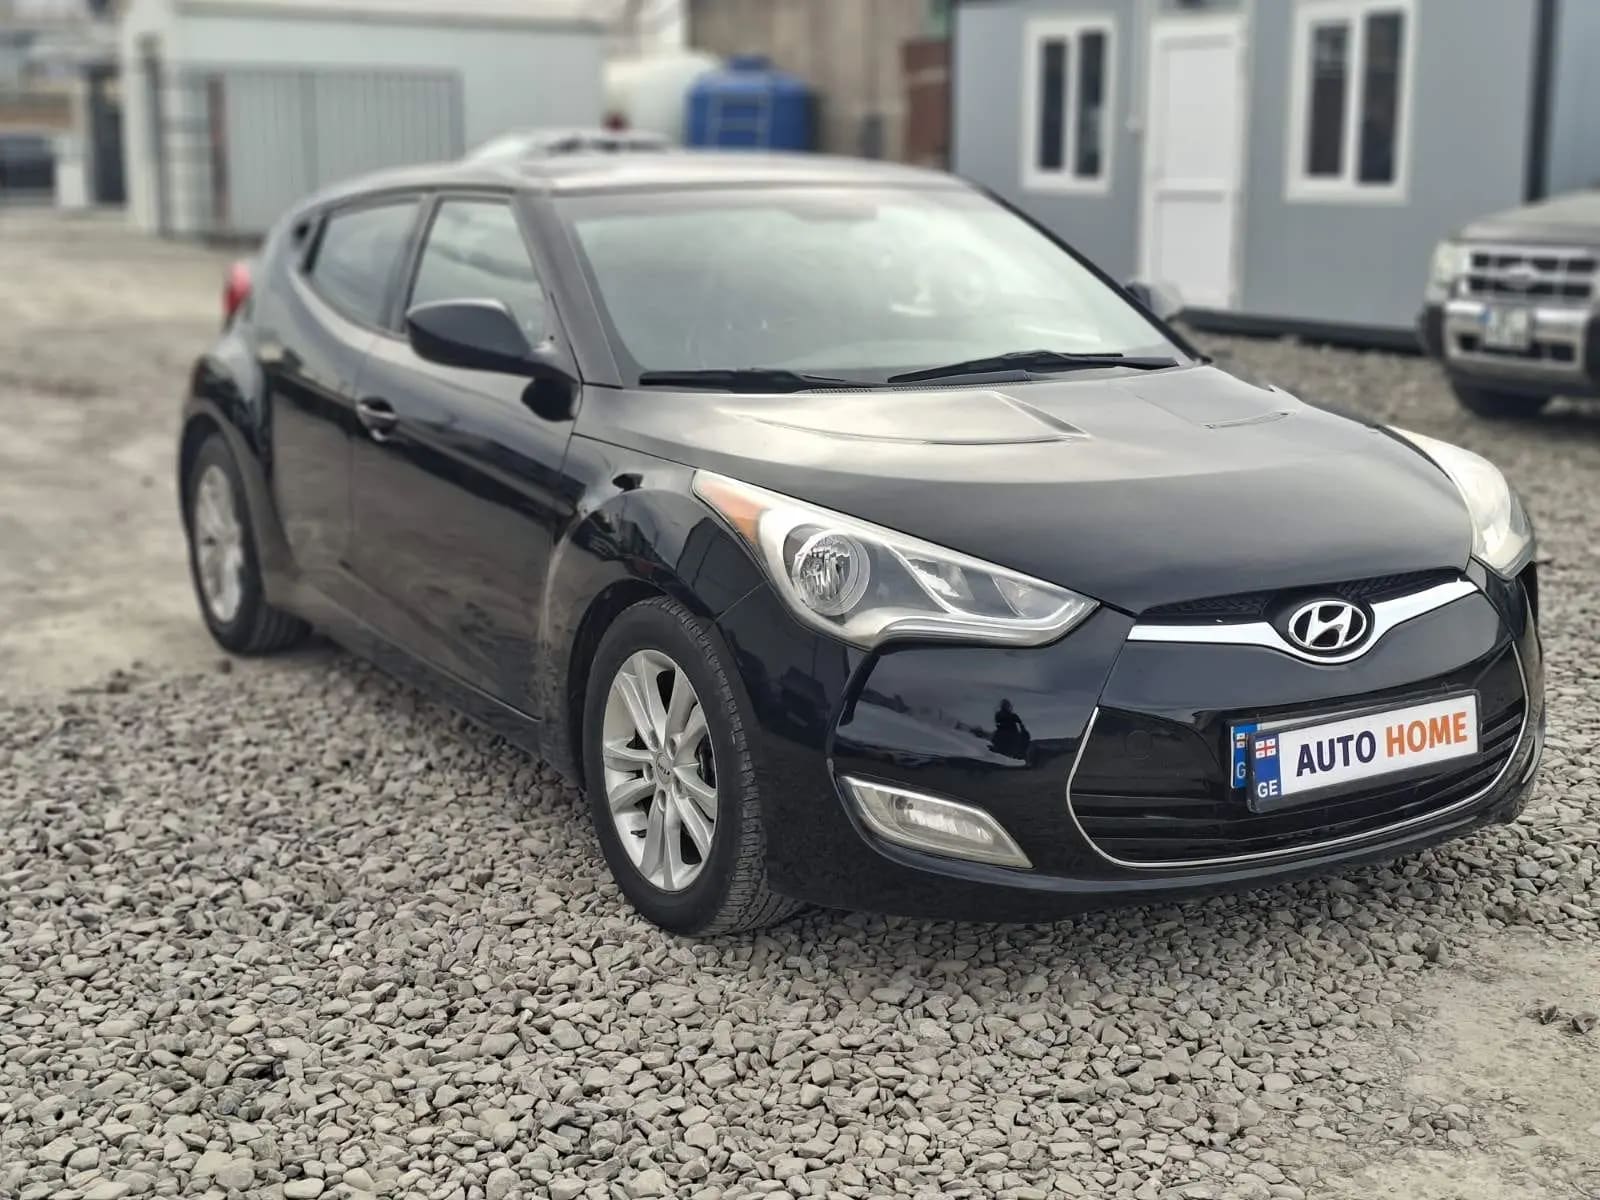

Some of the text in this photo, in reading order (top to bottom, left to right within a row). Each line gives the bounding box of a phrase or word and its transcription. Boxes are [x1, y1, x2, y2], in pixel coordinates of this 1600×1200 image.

[1296, 711, 1468, 777] AUTO HOME
[1236, 761, 1247, 779] G
[1257, 780, 1278, 798] GE
